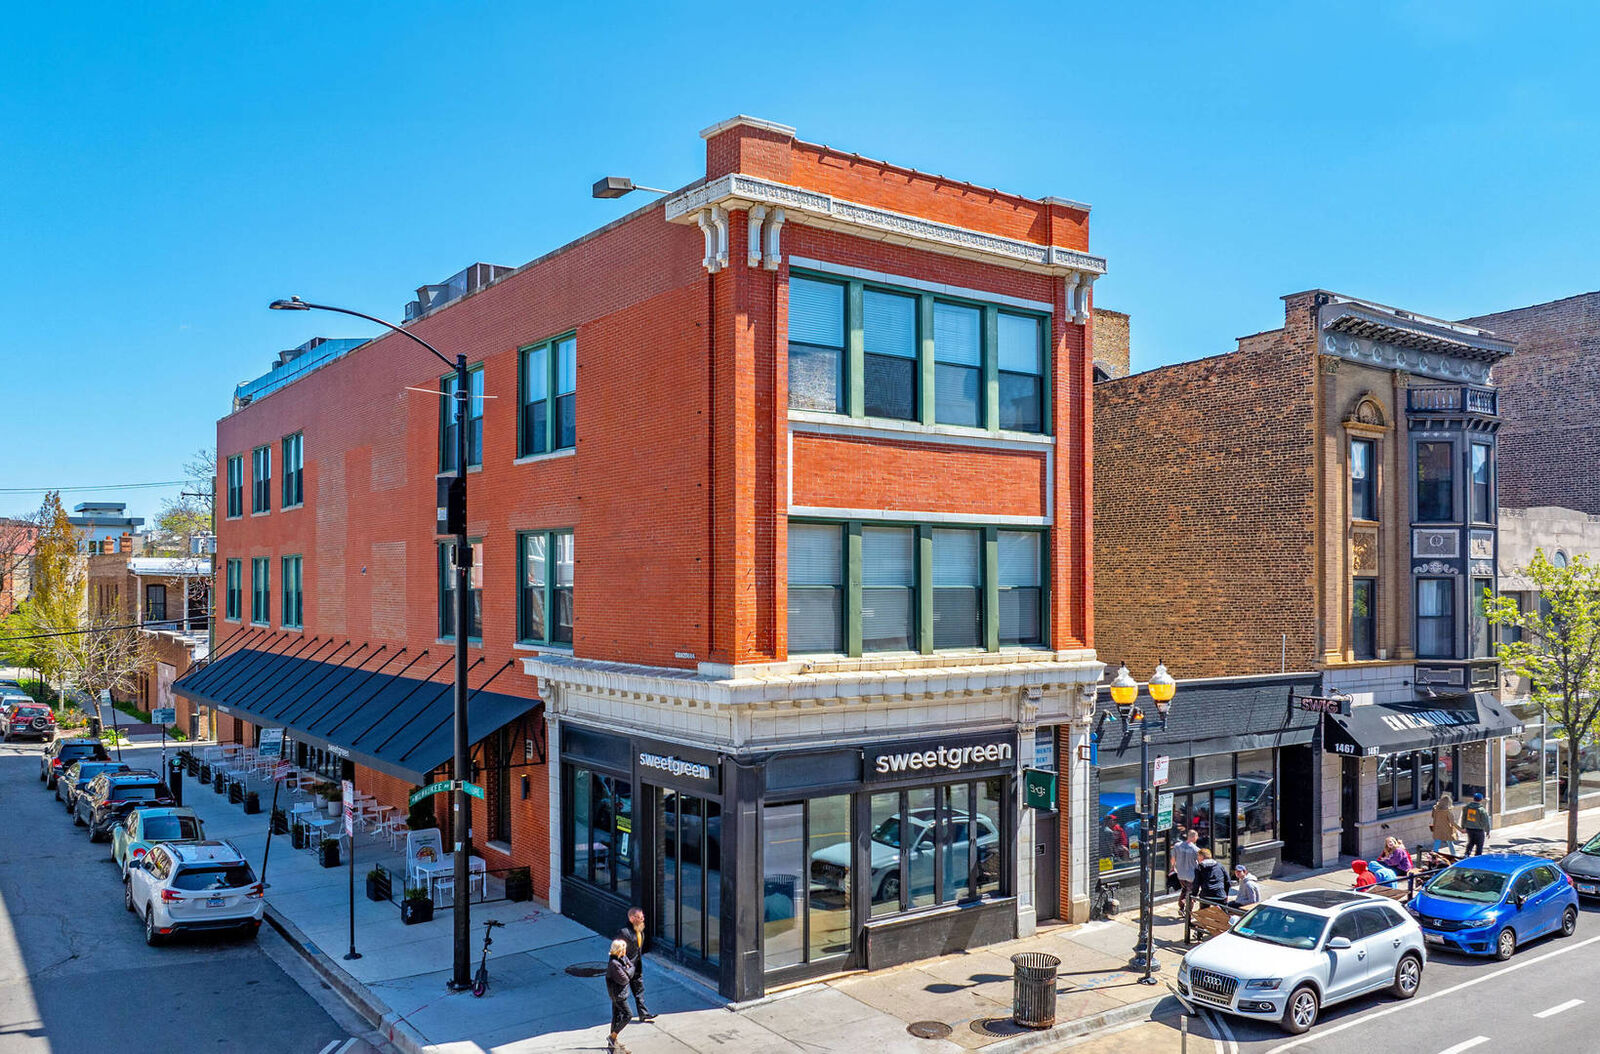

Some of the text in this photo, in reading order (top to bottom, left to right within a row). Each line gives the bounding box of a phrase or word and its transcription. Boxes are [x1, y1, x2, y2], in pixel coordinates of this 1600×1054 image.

[1301, 698, 1338, 713] SWIG
[875, 743, 1012, 773] sweetgreen
[1335, 743, 1355, 754] 1467
[640, 752, 710, 779] sweetgreen
